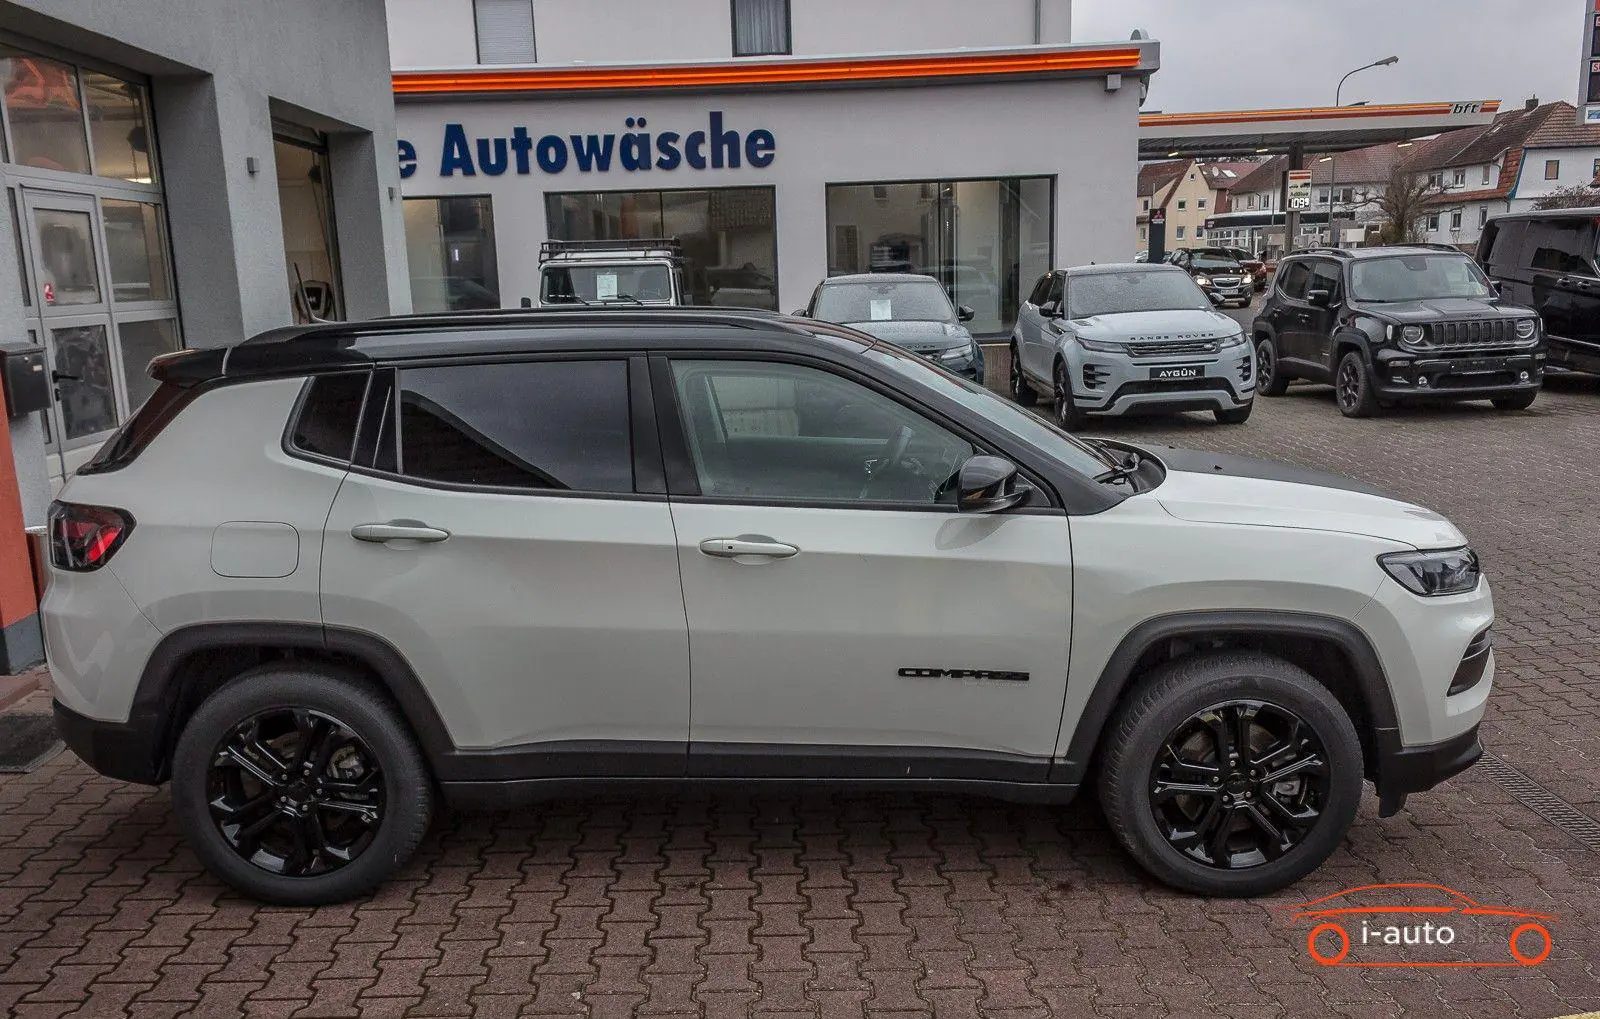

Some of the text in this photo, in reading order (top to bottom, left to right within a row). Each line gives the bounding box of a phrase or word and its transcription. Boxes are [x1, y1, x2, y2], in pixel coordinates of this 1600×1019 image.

[1453, 103, 1479, 114] bft
[439, 111, 776, 177] Autowäsche
[1159, 368, 1196, 377] AYGÜN
